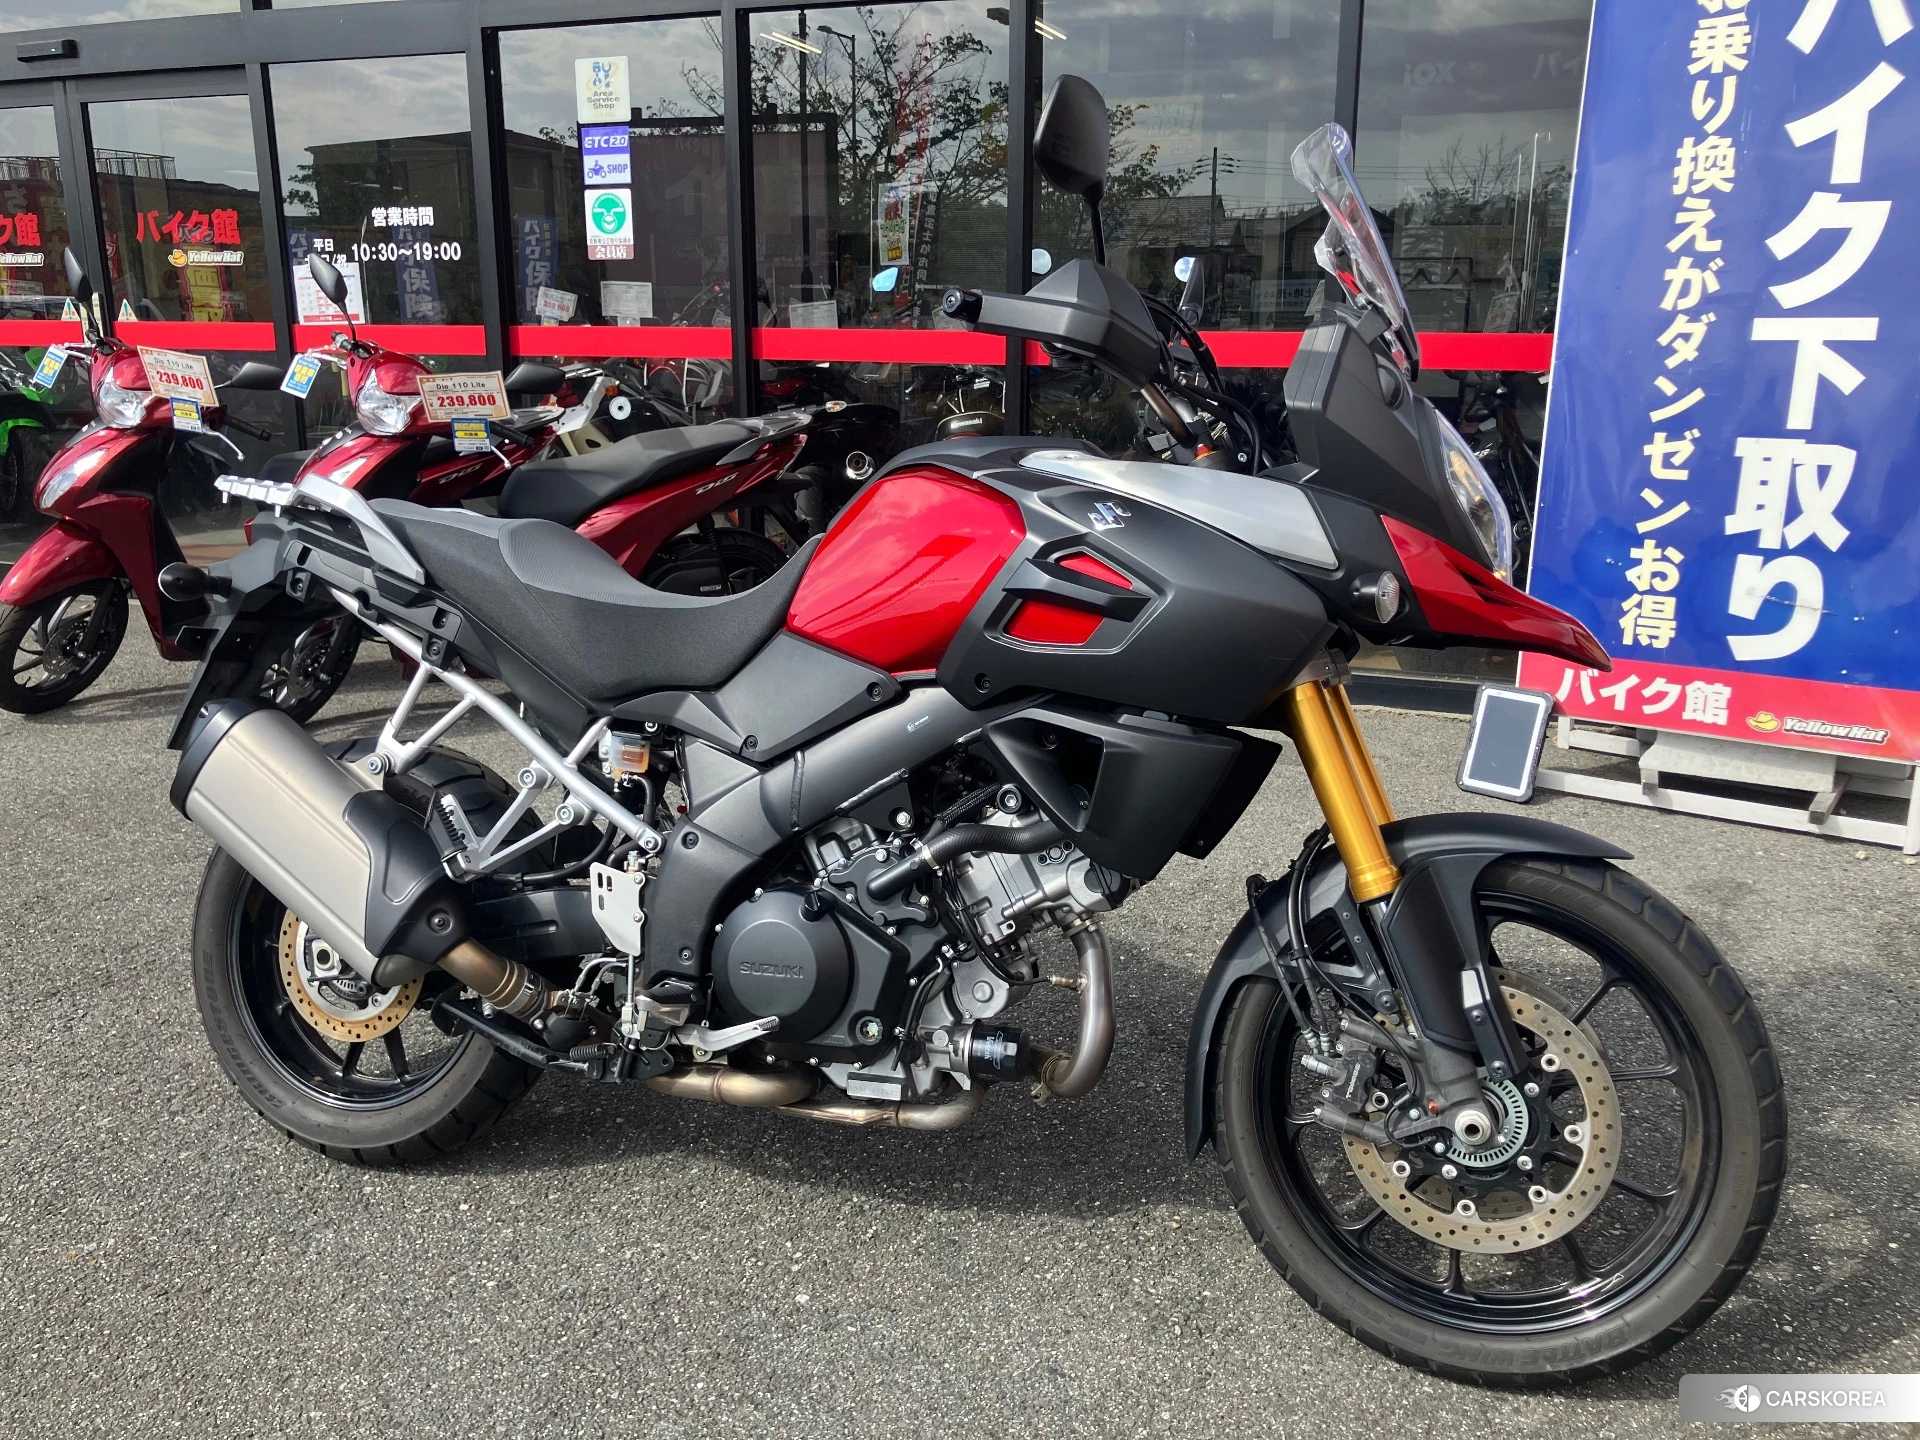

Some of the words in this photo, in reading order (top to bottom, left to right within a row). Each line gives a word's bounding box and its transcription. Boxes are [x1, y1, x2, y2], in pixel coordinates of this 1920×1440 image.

[586, 96, 621, 104] Service
[592, 102, 615, 110] Shop
[584, 135, 609, 149] ETC
[610, 136, 627, 147] 2.0
[606, 163, 629, 174] SHOP
[371, 206, 434, 227] 営業時間
[136, 208, 241, 245] バイク館
[313, 238, 334, 252] 平日
[595, 245, 628, 259] 会員店
[0, 253, 44, 267] ellowHat
[188, 252, 243, 265] YellowHat
[1619, 0, 1752, 649] 乗り換えがダンゼンお得
[156, 370, 204, 391] 239,800
[471, 380, 486, 388] Lite
[436, 394, 497, 408] 239,800
[1555, 667, 1733, 727] バイク館
[1783, 716, 1891, 745] YellowHat
[740, 961, 804, 979] SUZUKI
